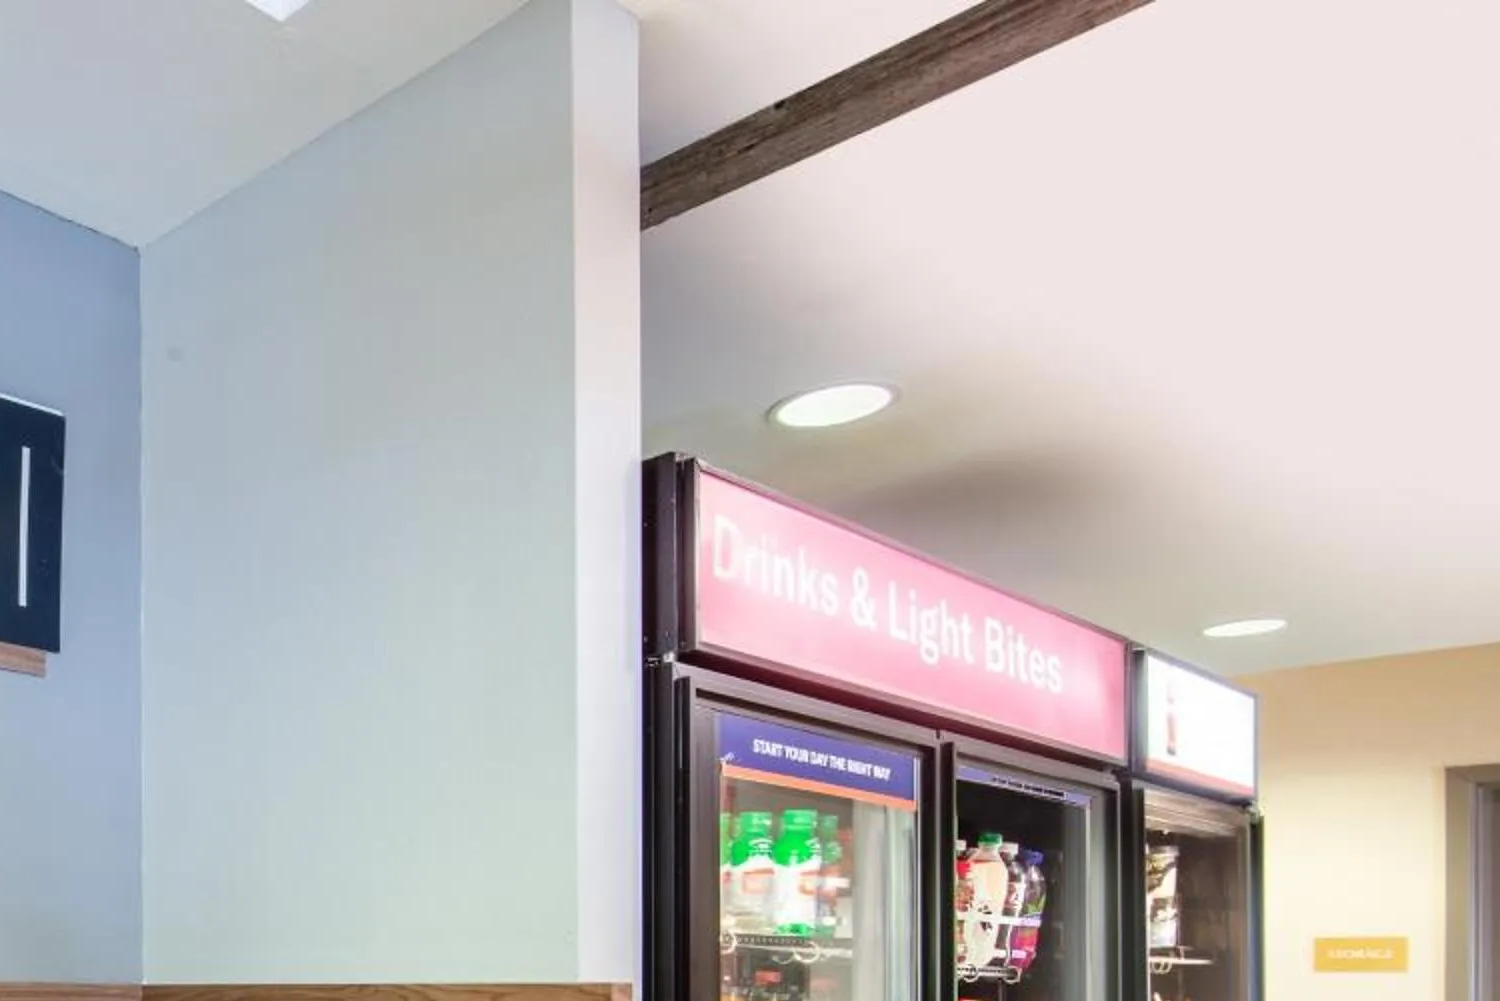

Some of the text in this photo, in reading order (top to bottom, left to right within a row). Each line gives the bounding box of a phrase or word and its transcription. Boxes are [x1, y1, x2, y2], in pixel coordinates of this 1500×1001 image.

[713, 515, 1064, 693] Drinks & Light Bites
[753, 738, 891, 780] START YOUR DAY THE RIGHT WAY
